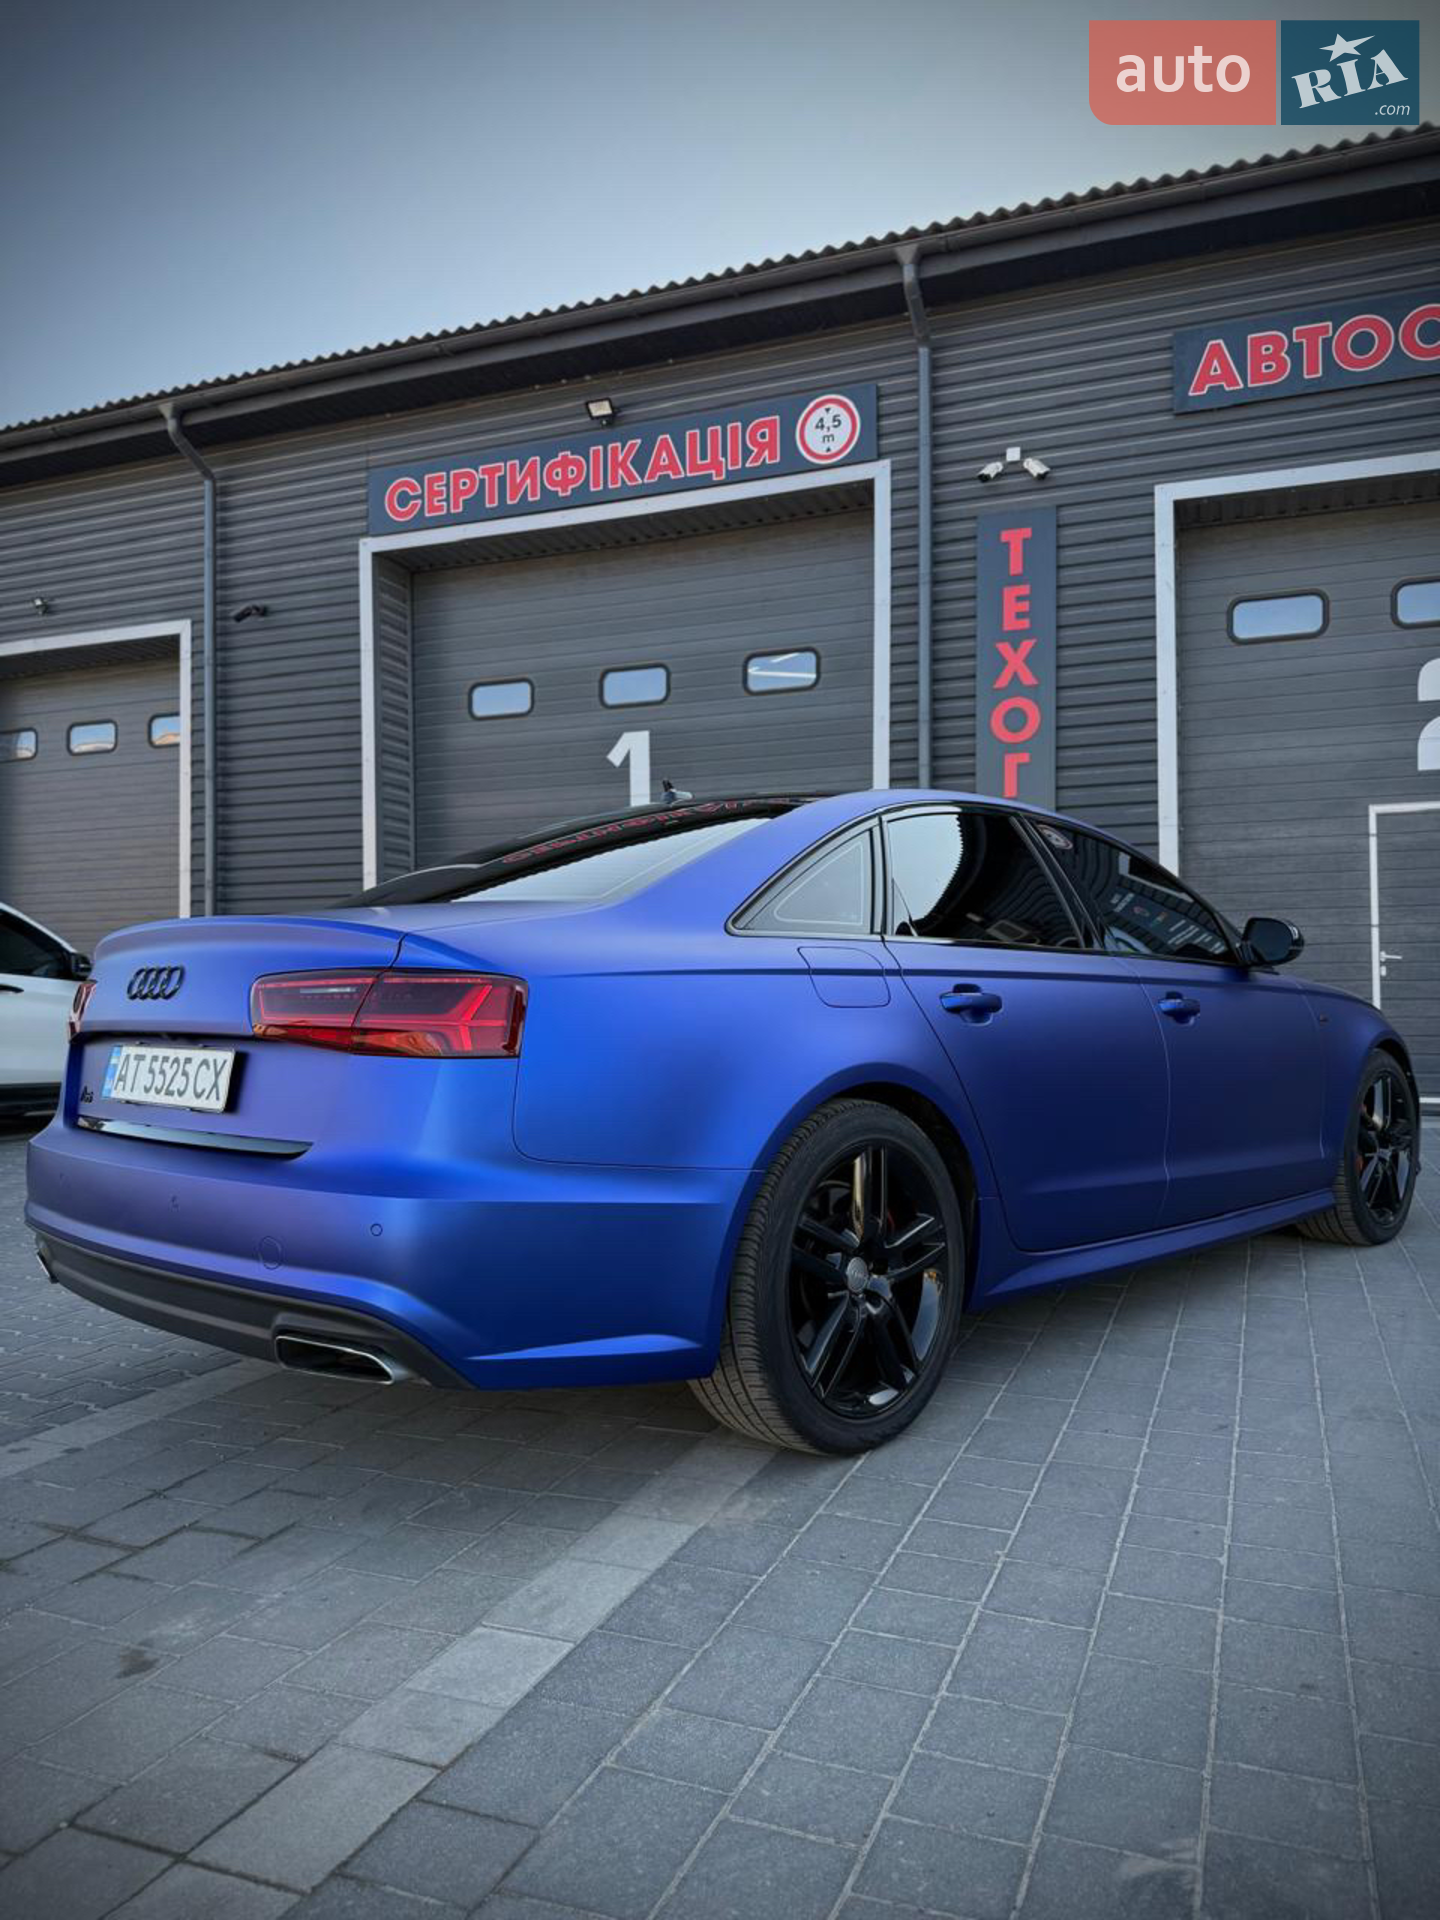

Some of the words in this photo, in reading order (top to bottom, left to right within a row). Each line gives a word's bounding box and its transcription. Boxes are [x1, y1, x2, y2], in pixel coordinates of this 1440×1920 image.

[815, 414, 842, 432] 4,5
[385, 415, 781, 522] СЕРТИФІКАЦІЯ
[990, 527, 1041, 798] ТЕХОГ
[606, 730, 650, 807] 1
[114, 1054, 146, 1093] AT
[143, 1055, 193, 1098] 5525
[193, 1058, 228, 1101] CX
